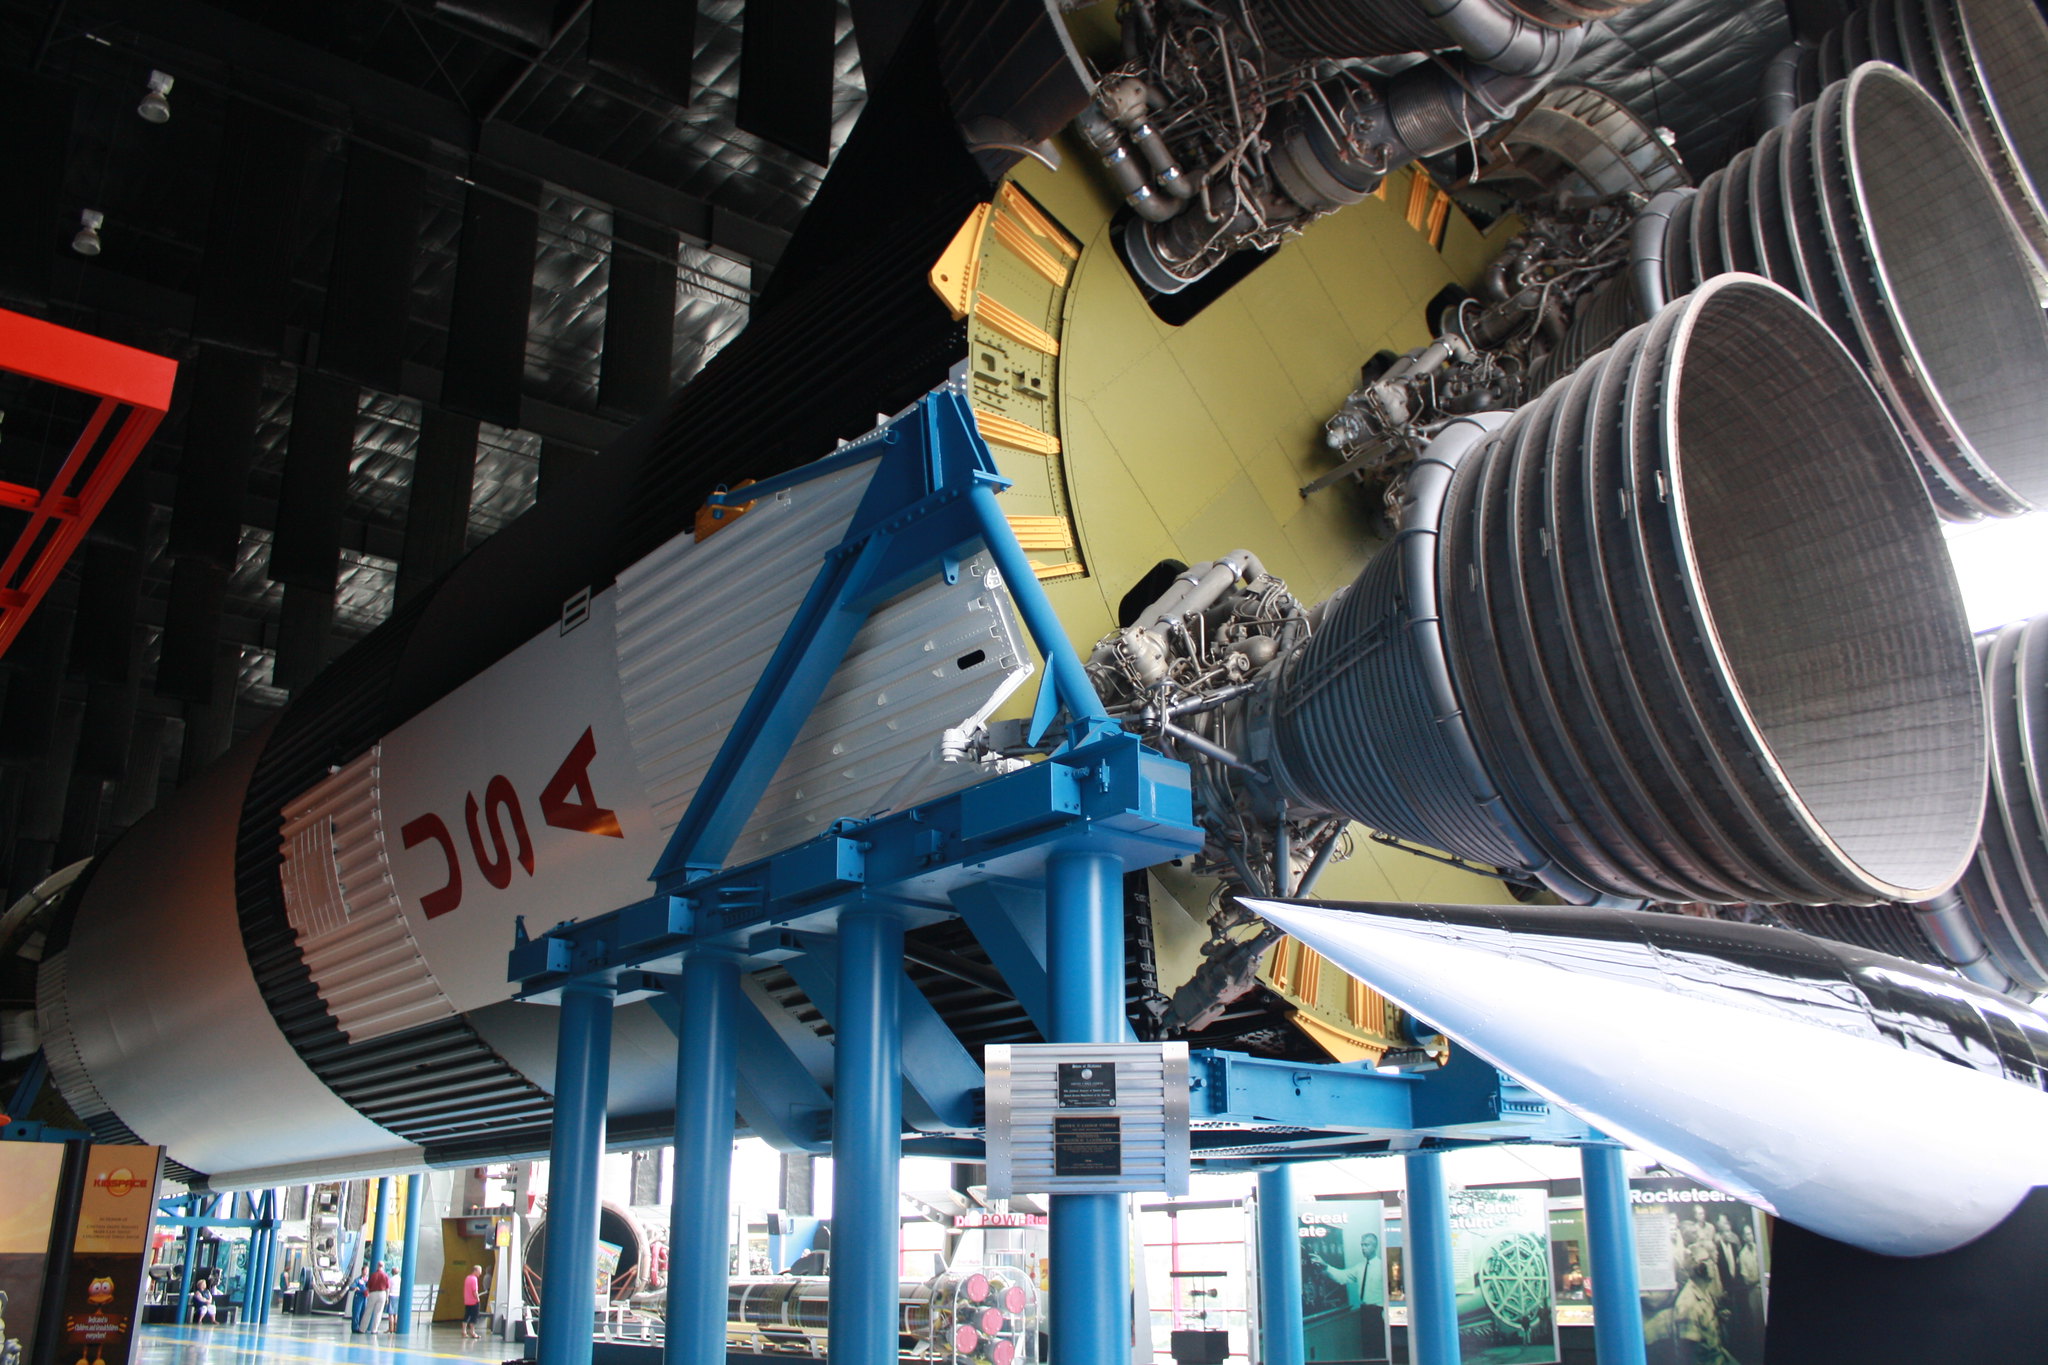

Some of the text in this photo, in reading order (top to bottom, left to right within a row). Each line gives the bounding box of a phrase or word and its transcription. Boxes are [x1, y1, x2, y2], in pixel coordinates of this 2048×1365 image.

[401, 724, 624, 920] USA
[1301, 1212, 1349, 1224] Great
[1450, 1217, 1494, 1229] aturn
[1298, 1225, 1327, 1237] ate
